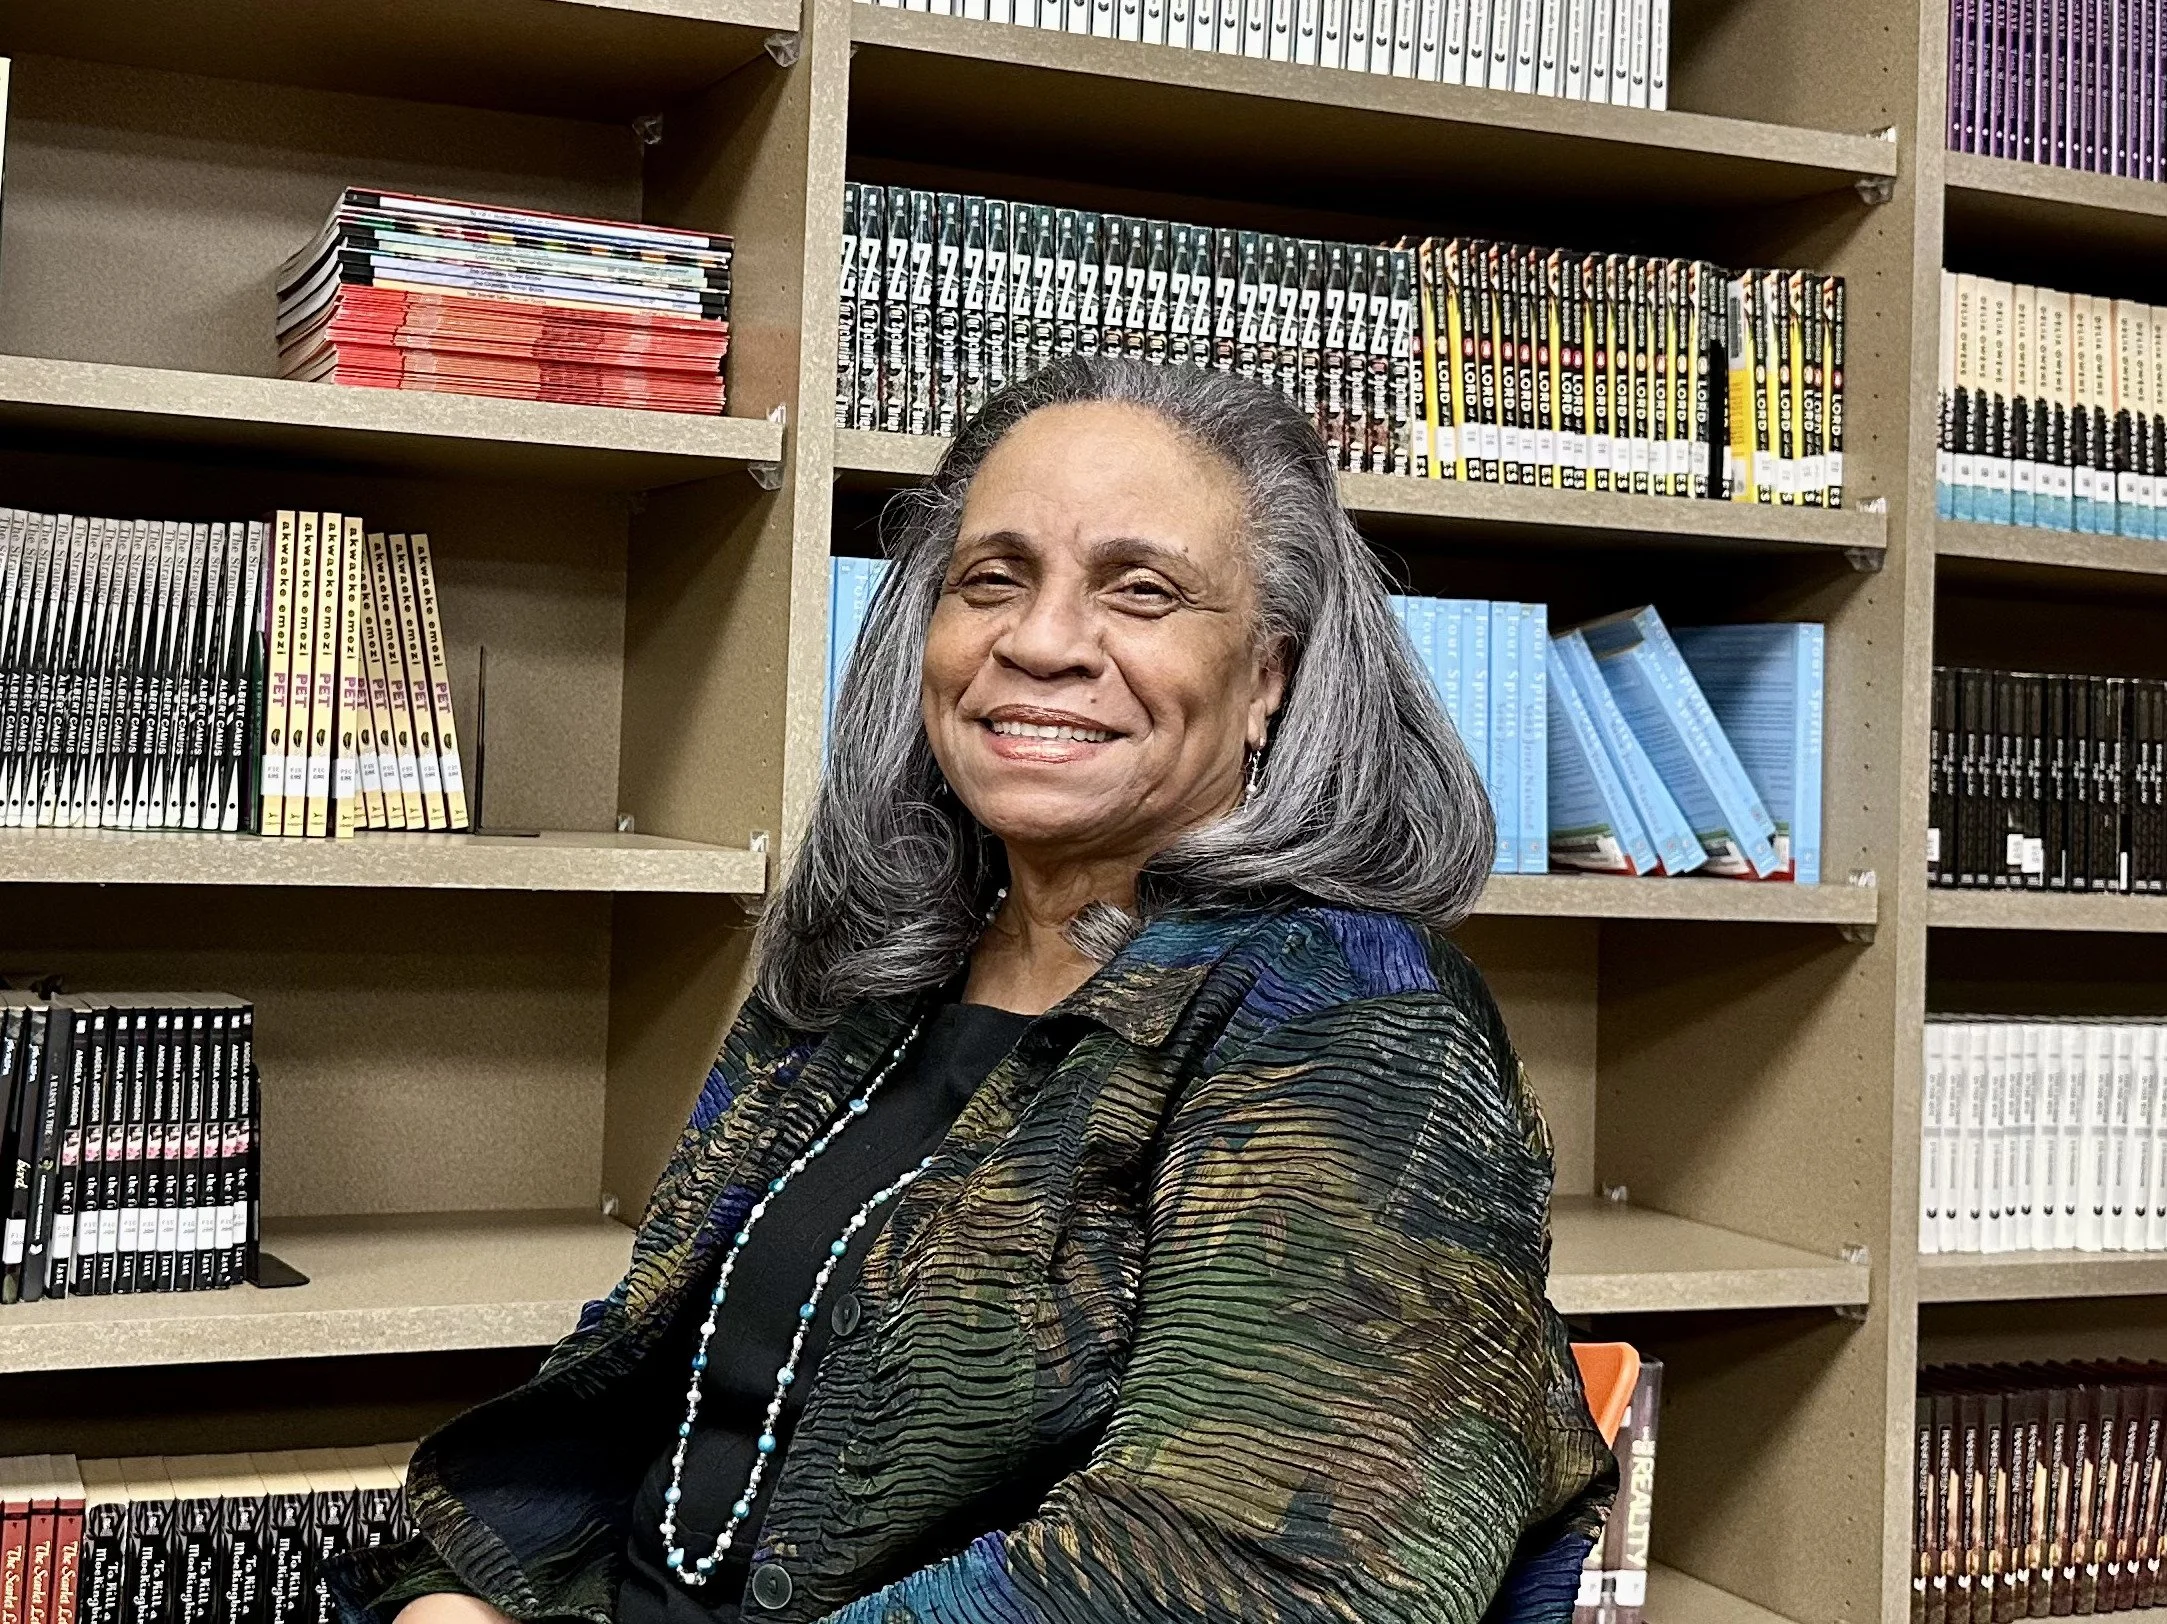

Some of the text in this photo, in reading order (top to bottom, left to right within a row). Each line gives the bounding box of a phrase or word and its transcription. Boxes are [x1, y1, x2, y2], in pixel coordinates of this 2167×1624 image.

[861, 238, 880, 300] Z
[888, 237, 908, 300] Z
[913, 242, 932, 304] Z
[940, 246, 959, 308] Z
[965, 247, 984, 310] Z
[1014, 254, 1031, 315] Z
[1058, 260, 1076, 320] Z
[1104, 265, 1123, 326] Z
[1172, 274, 1190, 333] Z
[1326, 289, 1344, 348] Z
[1464, 362, 1477, 405] LORD
[1482, 365, 1494, 408] LORD
[1503, 366, 1515, 409] LORD
[1520, 369, 1532, 412] LORD
[1539, 371, 1550, 414] LORD
[1562, 372, 1573, 415] LORD
[1573, 375, 1583, 417] LORD
[1596, 375, 1606, 418] LORD
[1617, 375, 1627, 418] LORD
[1636, 377, 1646, 420] LORD
[1677, 379, 1687, 421] LORD
[1757, 390, 1766, 432] LORD
[1780, 389, 1790, 432] LORD
[1832, 394, 1842, 436] LORD
[21, 522, 39, 602] The Stranger
[68, 525, 87, 604] The Stranger
[84, 525, 102, 605] The Stranger
[159, 530, 176, 608] The Stranger
[189, 530, 206, 609] The Stranger
[207, 530, 223, 608] The Stranger
[277, 522, 291, 655] akwaeke emezi
[299, 523, 314, 656] akwaeke emezi
[323, 523, 337, 655] akwaeke emezi
[347, 528, 358, 659] akwaeke emezi
[374, 543, 399, 664] akwaeke emezi
[396, 544, 420, 664] akwaeke emezi
[418, 546, 442, 666] akwaeke emezi
[366, 616, 380, 662] emezi
[1476, 615, 1488, 658] Four
[1507, 616, 1519, 659] Four
[1534, 618, 1546, 660] Four
[1812, 636, 1823, 678] Four
[3, 673, 20, 752] ALBERT CAMUS
[17, 674, 34, 752] ALBERT CAMUS
[66, 675, 82, 753] ALBERT CAMUS
[81, 677, 97, 754] ALBERT CAMUS
[144, 677, 159, 754] ALBERT CAMUS
[194, 678, 208, 755] ALBERT CAMUS
[214, 679, 228, 756] ALBERT CAMUS
[232, 679, 247, 756] ALBERT CAMUS
[273, 672, 286, 707] PET
[295, 674, 308, 708] PET
[318, 673, 331, 708] PET
[344, 677, 356, 711] PET
[372, 678, 387, 710] PET
[391, 680, 406, 712] PET
[413, 680, 428, 712] PET
[436, 682, 451, 713] PET
[15, 1159, 30, 1190] bird
[6, 1545, 22, 1570] The
[34, 1541, 50, 1565] The
[63, 1541, 78, 1565] The
[287, 1551, 301, 1609] To Kill a
[104, 1562, 119, 1621] To Kill a
[151, 1560, 165, 1619] To Kill a
[197, 1557, 211, 1616] To Kill a
[242, 1555, 257, 1614] To Kill a
